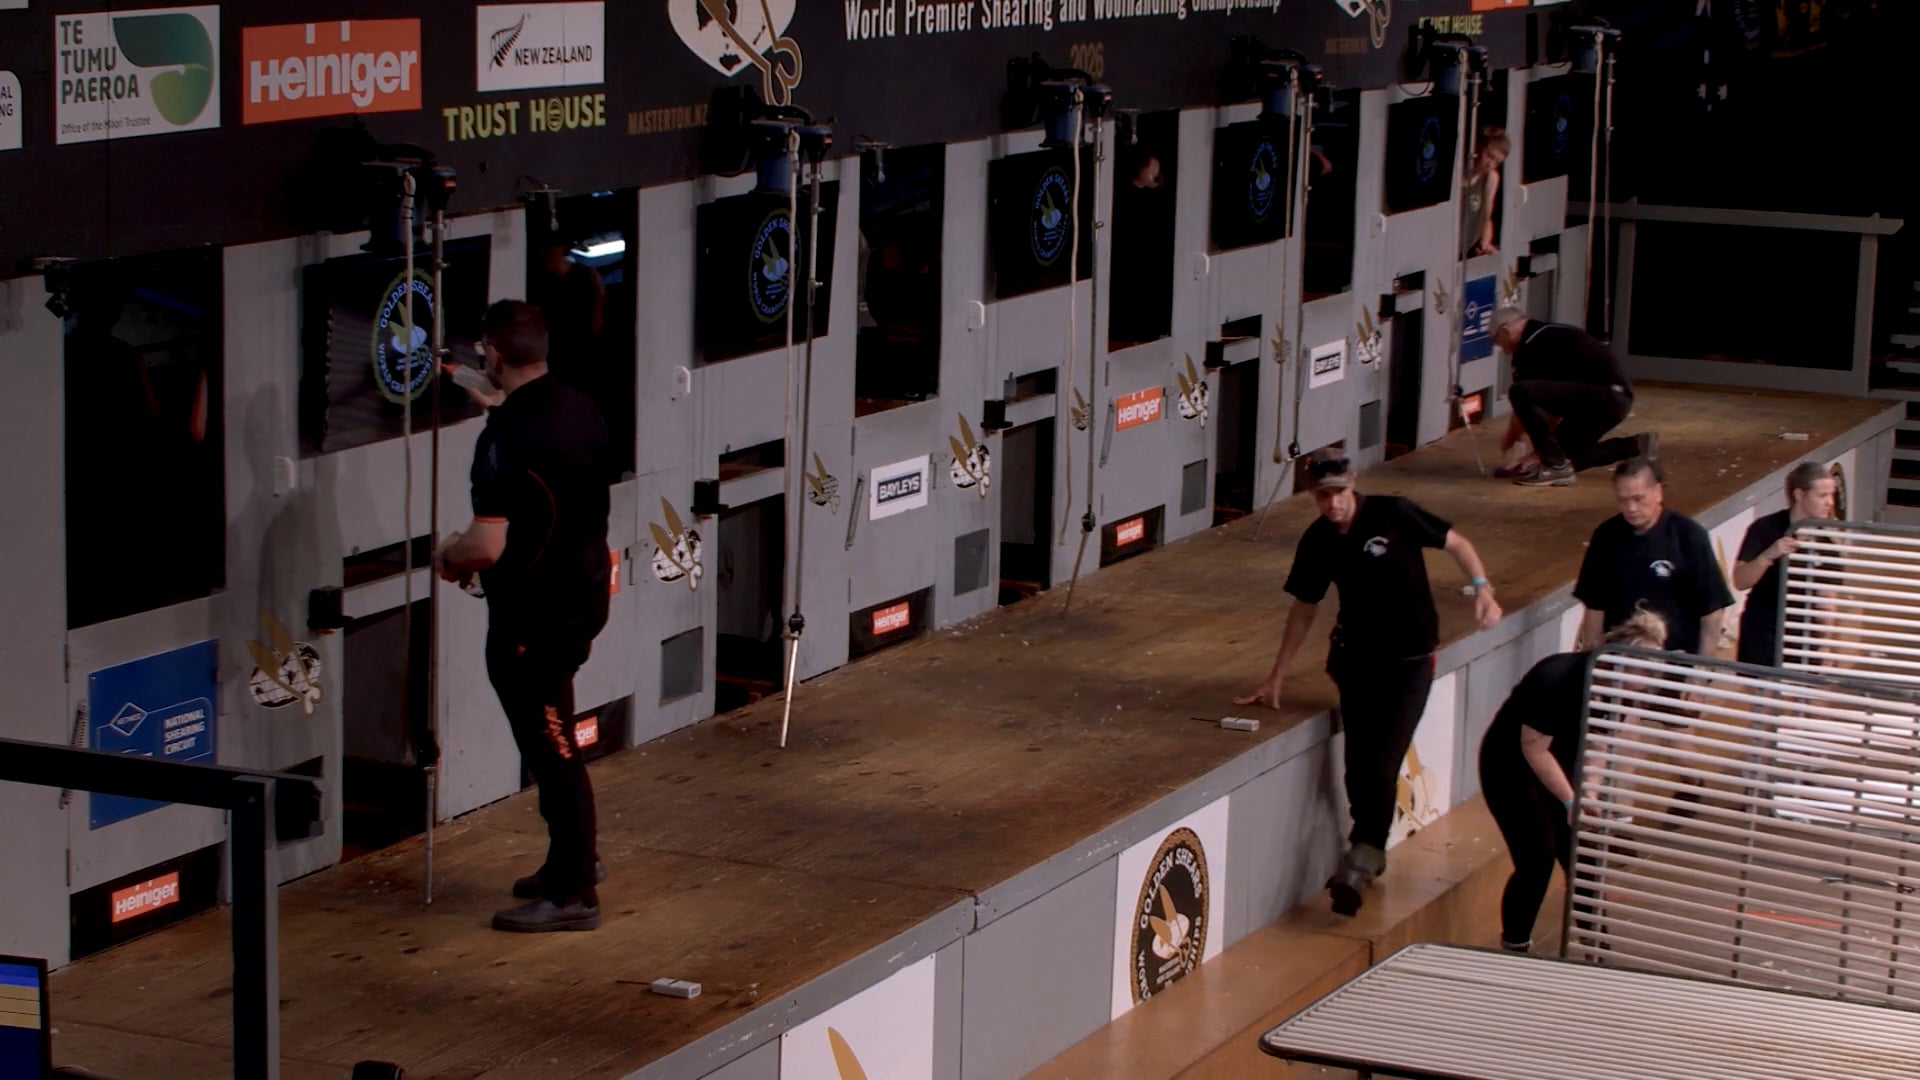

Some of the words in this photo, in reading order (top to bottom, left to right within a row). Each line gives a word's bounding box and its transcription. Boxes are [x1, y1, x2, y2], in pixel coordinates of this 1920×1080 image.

[61, 20, 83, 45] TE
[844, 0, 896, 40] World
[904, 0, 975, 35] Premier
[981, 0, 1053, 31] Shearing
[1059, 0, 1087, 22] and
[61, 46, 117, 74] TUMU
[250, 23, 417, 107] Heiniger
[515, 48, 540, 66] NEW
[543, 45, 593, 65] ZEALAND
[1070, 40, 1104, 79] 2026
[62, 74, 140, 104] PAEROA
[442, 101, 520, 141] TRUST
[529, 94, 606, 132] HOUSE
[1118, 391, 1160, 425] Heiniger
[879, 475, 920, 500] BAYLEYS
[162, 709, 206, 731] NATIONAL
[162, 721, 206, 743] SHEARING
[162, 736, 197, 756] CIRCUIT
[115, 880, 179, 915] Heiniger
[1140, 850, 1175, 929] GOLDEN
[1174, 847, 1203, 899] SHEARS
